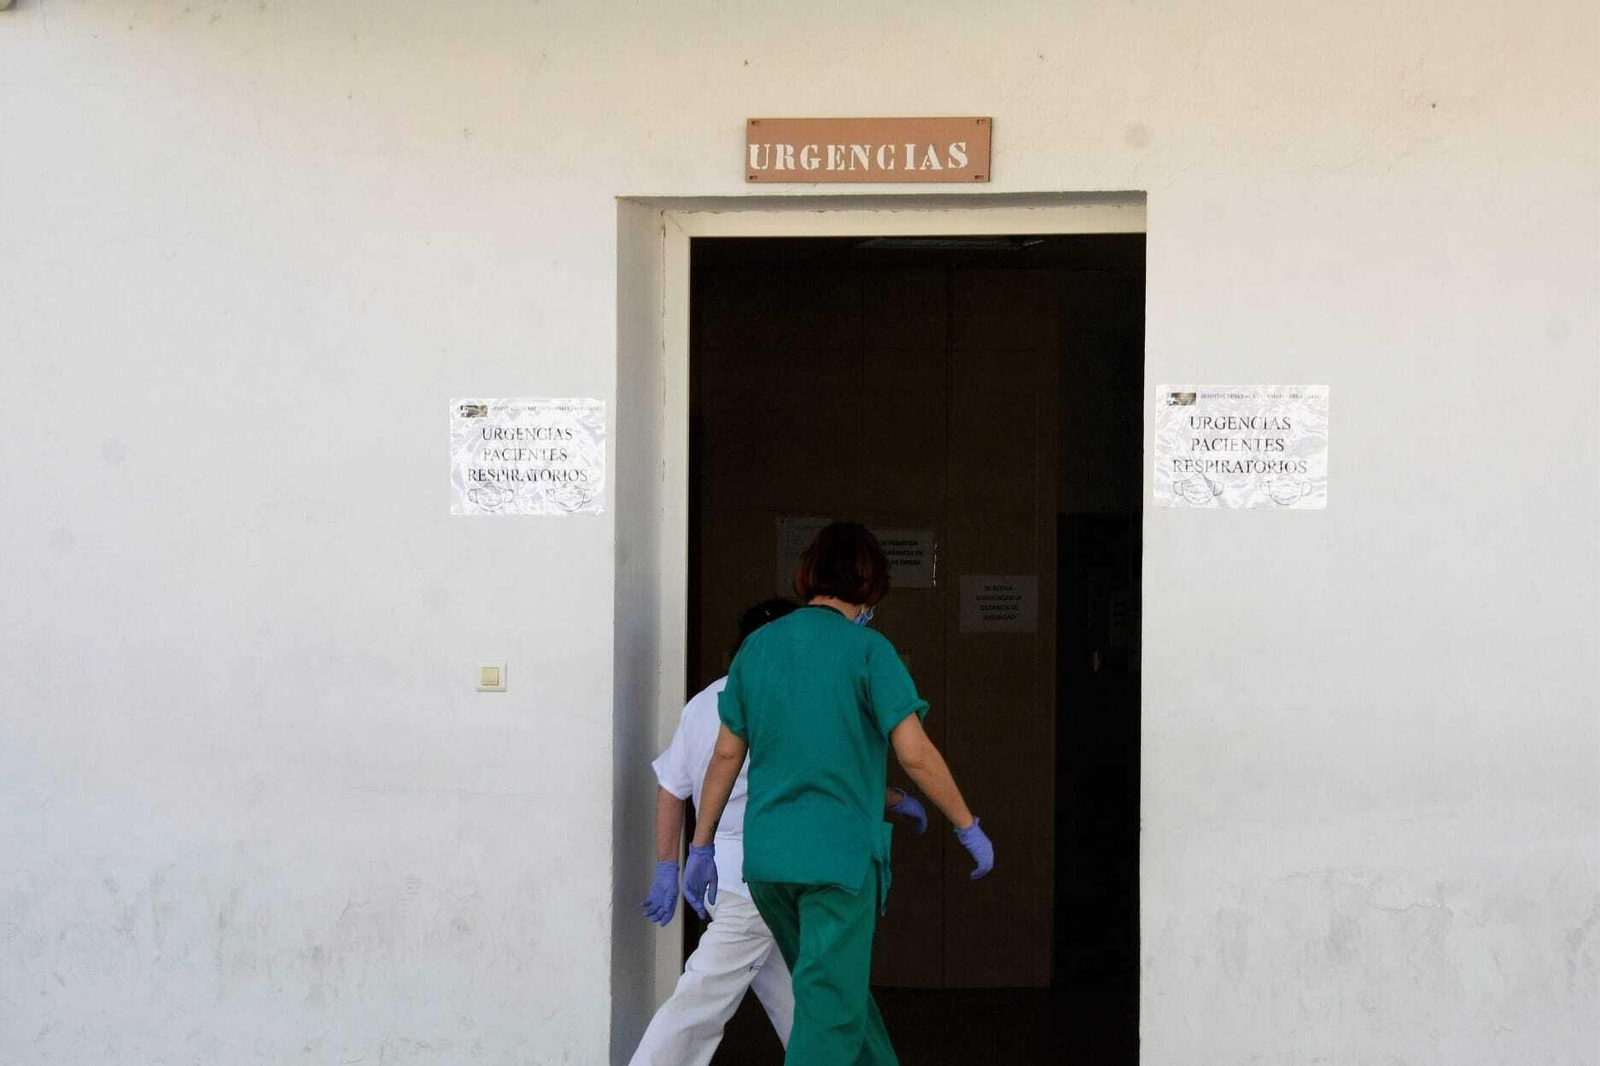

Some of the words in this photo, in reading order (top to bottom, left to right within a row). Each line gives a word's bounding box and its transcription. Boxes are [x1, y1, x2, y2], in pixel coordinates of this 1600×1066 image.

[748, 142, 968, 171] URGENCIAS
[1190, 416, 1291, 430] URGENCIAS
[482, 427, 573, 441] URGENCIAS
[1191, 437, 1284, 452] PACIENTES
[483, 448, 568, 461] PACIENTES
[1172, 459, 1307, 474] RESPIRATORIOS
[467, 468, 588, 482] RESPIRATORIOS
